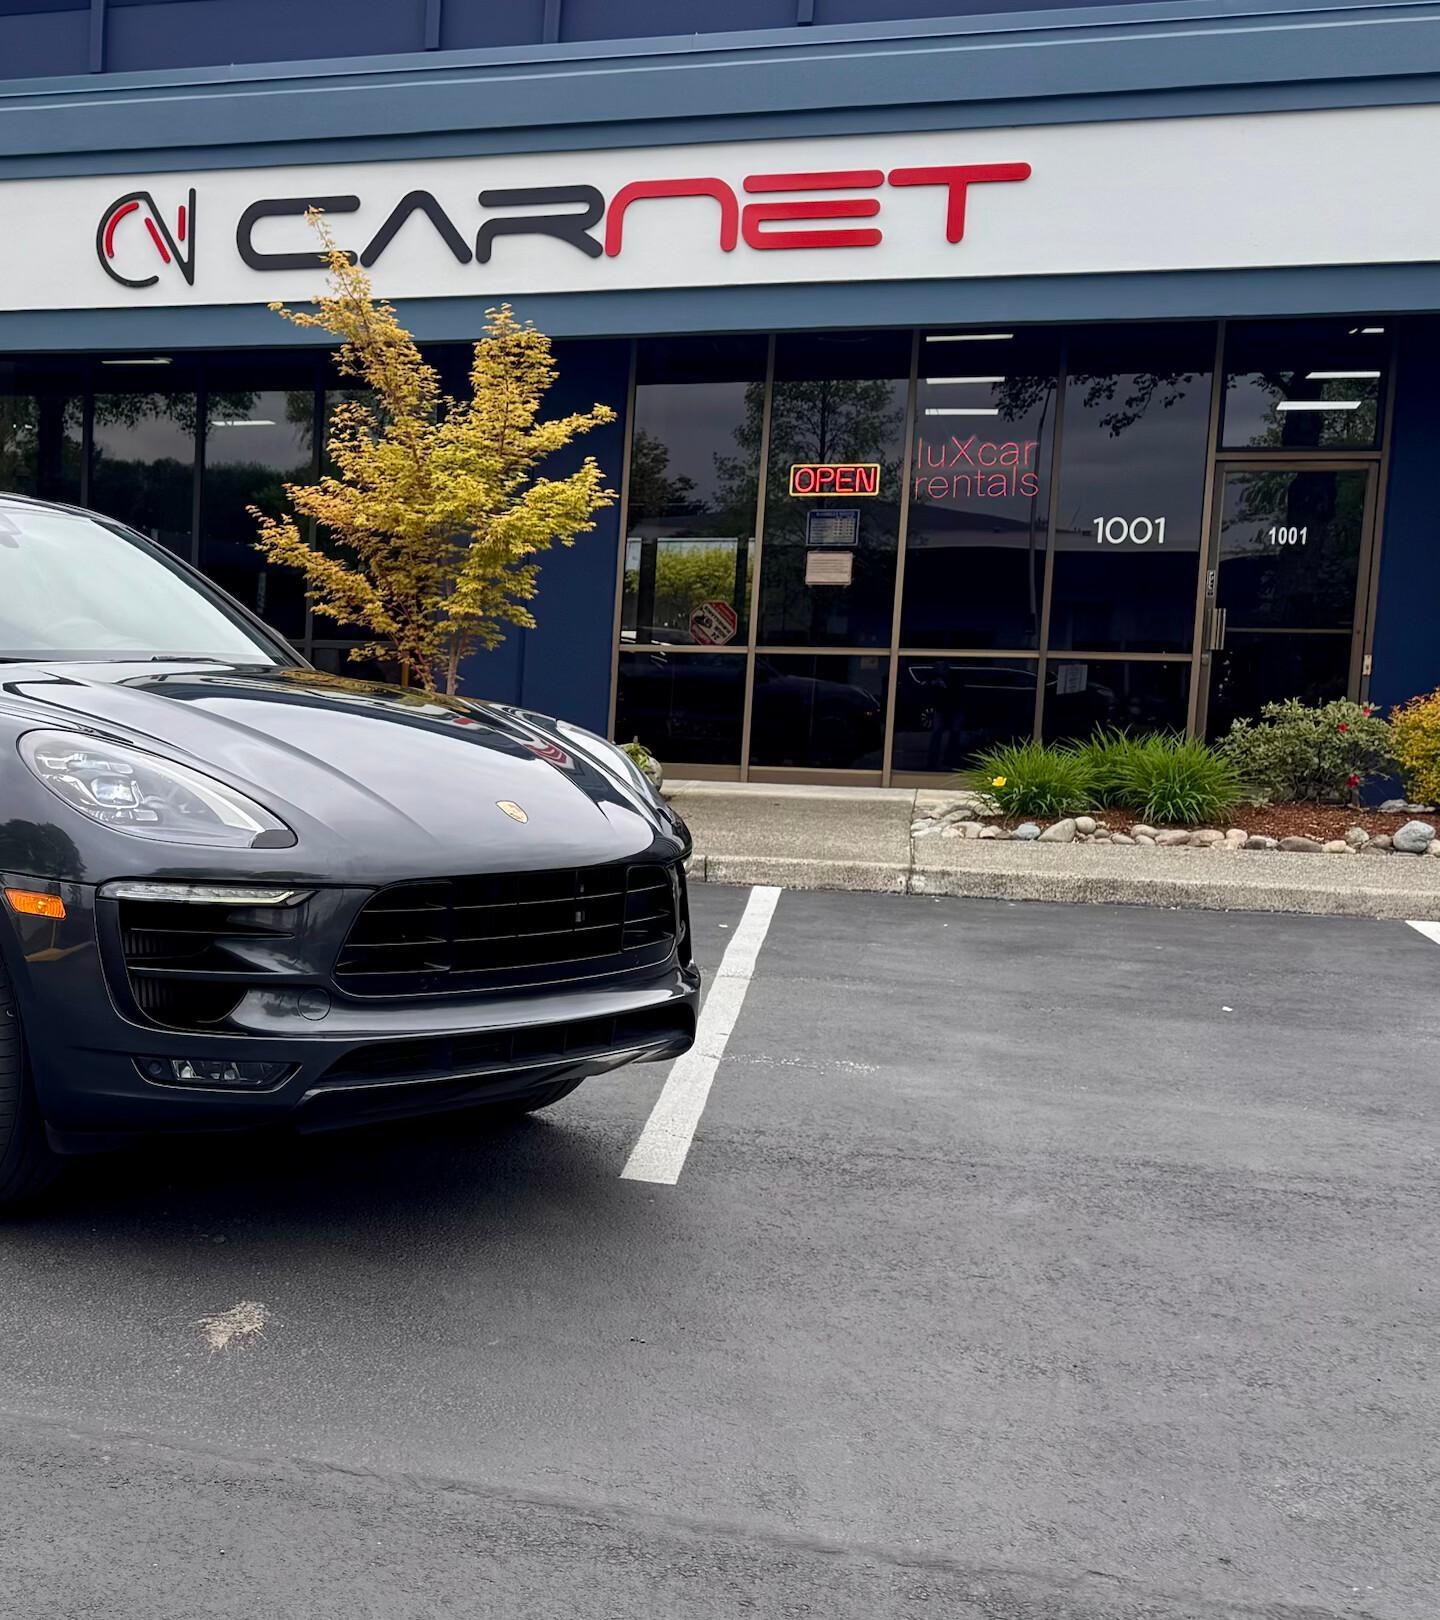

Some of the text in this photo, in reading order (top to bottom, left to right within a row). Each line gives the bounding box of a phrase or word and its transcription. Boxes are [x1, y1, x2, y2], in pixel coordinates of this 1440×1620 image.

[236, 161, 1031, 271] CARNET
[794, 467, 876, 493] OPEN
[914, 466, 1040, 500] rentals
[1093, 516, 1166, 545] 1001
[1268, 526, 1308, 546] 1001
